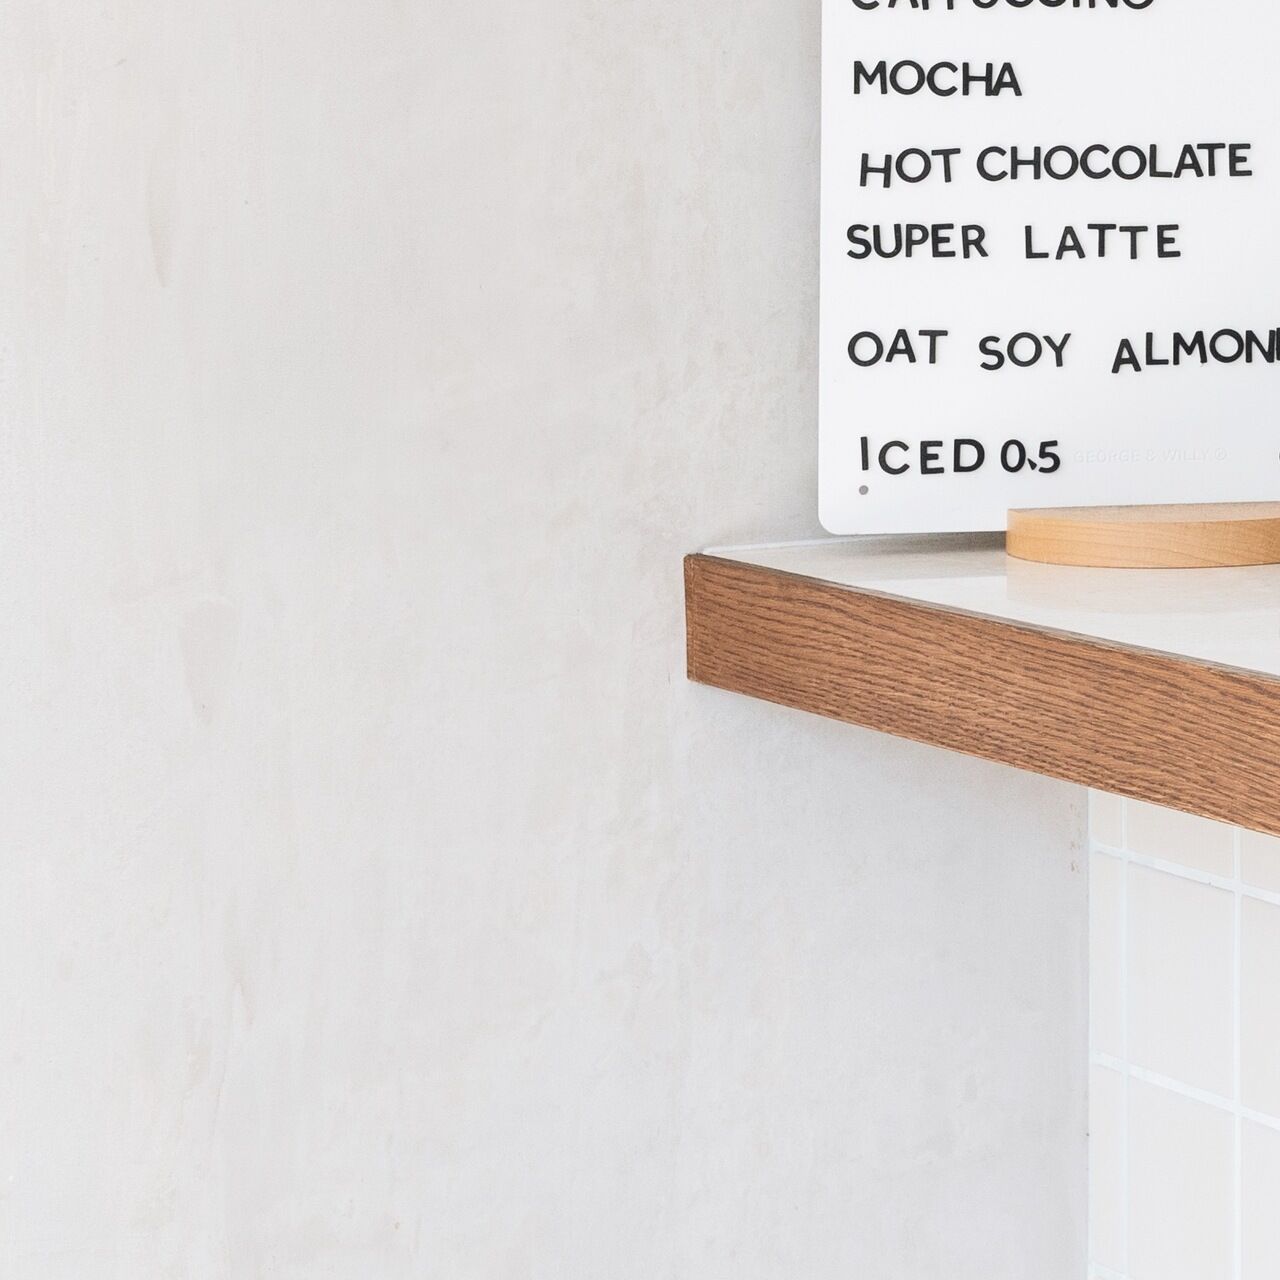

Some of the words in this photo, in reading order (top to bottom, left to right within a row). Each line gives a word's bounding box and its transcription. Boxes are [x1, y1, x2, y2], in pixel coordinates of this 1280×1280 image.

[854, 60, 1022, 96] MOCHA
[860, 148, 960, 188] HOT
[977, 143, 1253, 181] CHOCOLATE
[847, 224, 988, 259] SUPER
[1025, 223, 1180, 259] LATTE
[848, 329, 948, 366] OAT
[979, 332, 1071, 370] SOY
[861, 436, 985, 474] ICED
[1001, 440, 1060, 474] 0.5
